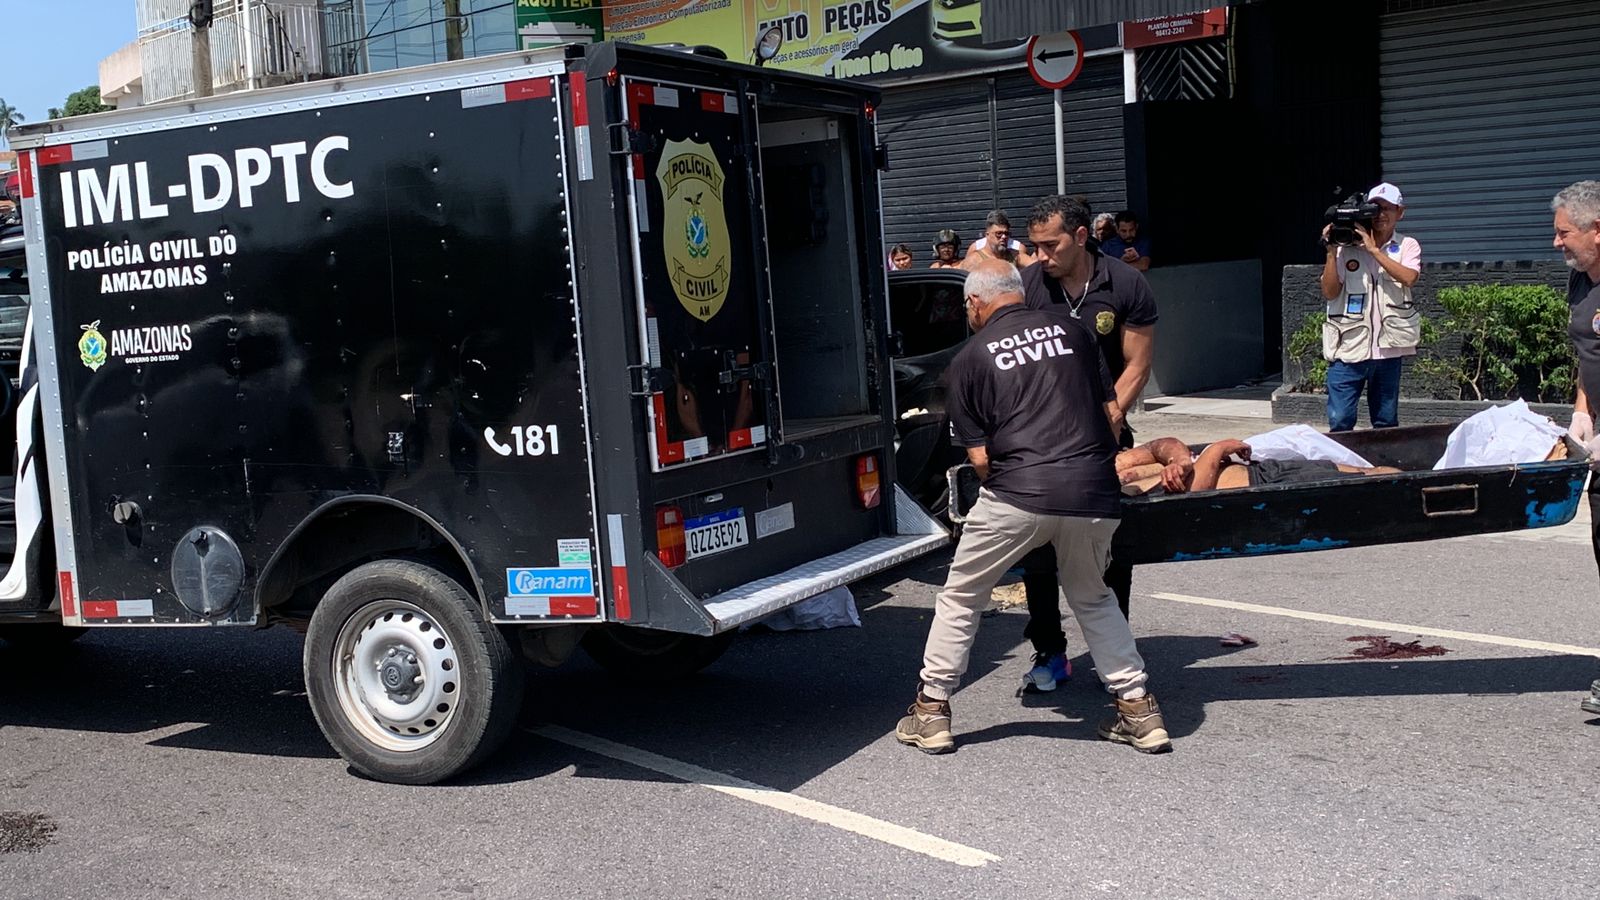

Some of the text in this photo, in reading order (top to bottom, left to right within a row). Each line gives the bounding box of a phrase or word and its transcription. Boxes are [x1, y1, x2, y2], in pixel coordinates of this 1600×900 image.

[825, 0, 892, 33] PEÇAS
[1147, 18, 1194, 31] PLANTÃO CRIMINAL
[769, 53, 788, 65] eças
[789, 51, 794, 60] e
[829, 43, 841, 54] em
[842, 38, 859, 53] geral
[890, 43, 923, 70] Óleo
[59, 134, 355, 229] IML-DPTC
[672, 155, 713, 181] POLÍCIA
[67, 233, 238, 271] POLÍCIA CIVIL DO
[100, 264, 208, 295] AMAZONAS
[685, 279, 719, 298] CIVIL
[699, 305, 711, 317] AM
[111, 323, 193, 356] AMAZONAS
[986, 324, 1067, 354] POLÍCIA
[994, 337, 1074, 371] CIVIL
[125, 356, 150, 364] GOVERNO
[158, 354, 180, 362] ESTADO
[510, 424, 559, 456] 181
[690, 520, 743, 554] QZZ3E92
[516, 570, 586, 593] Ranam
